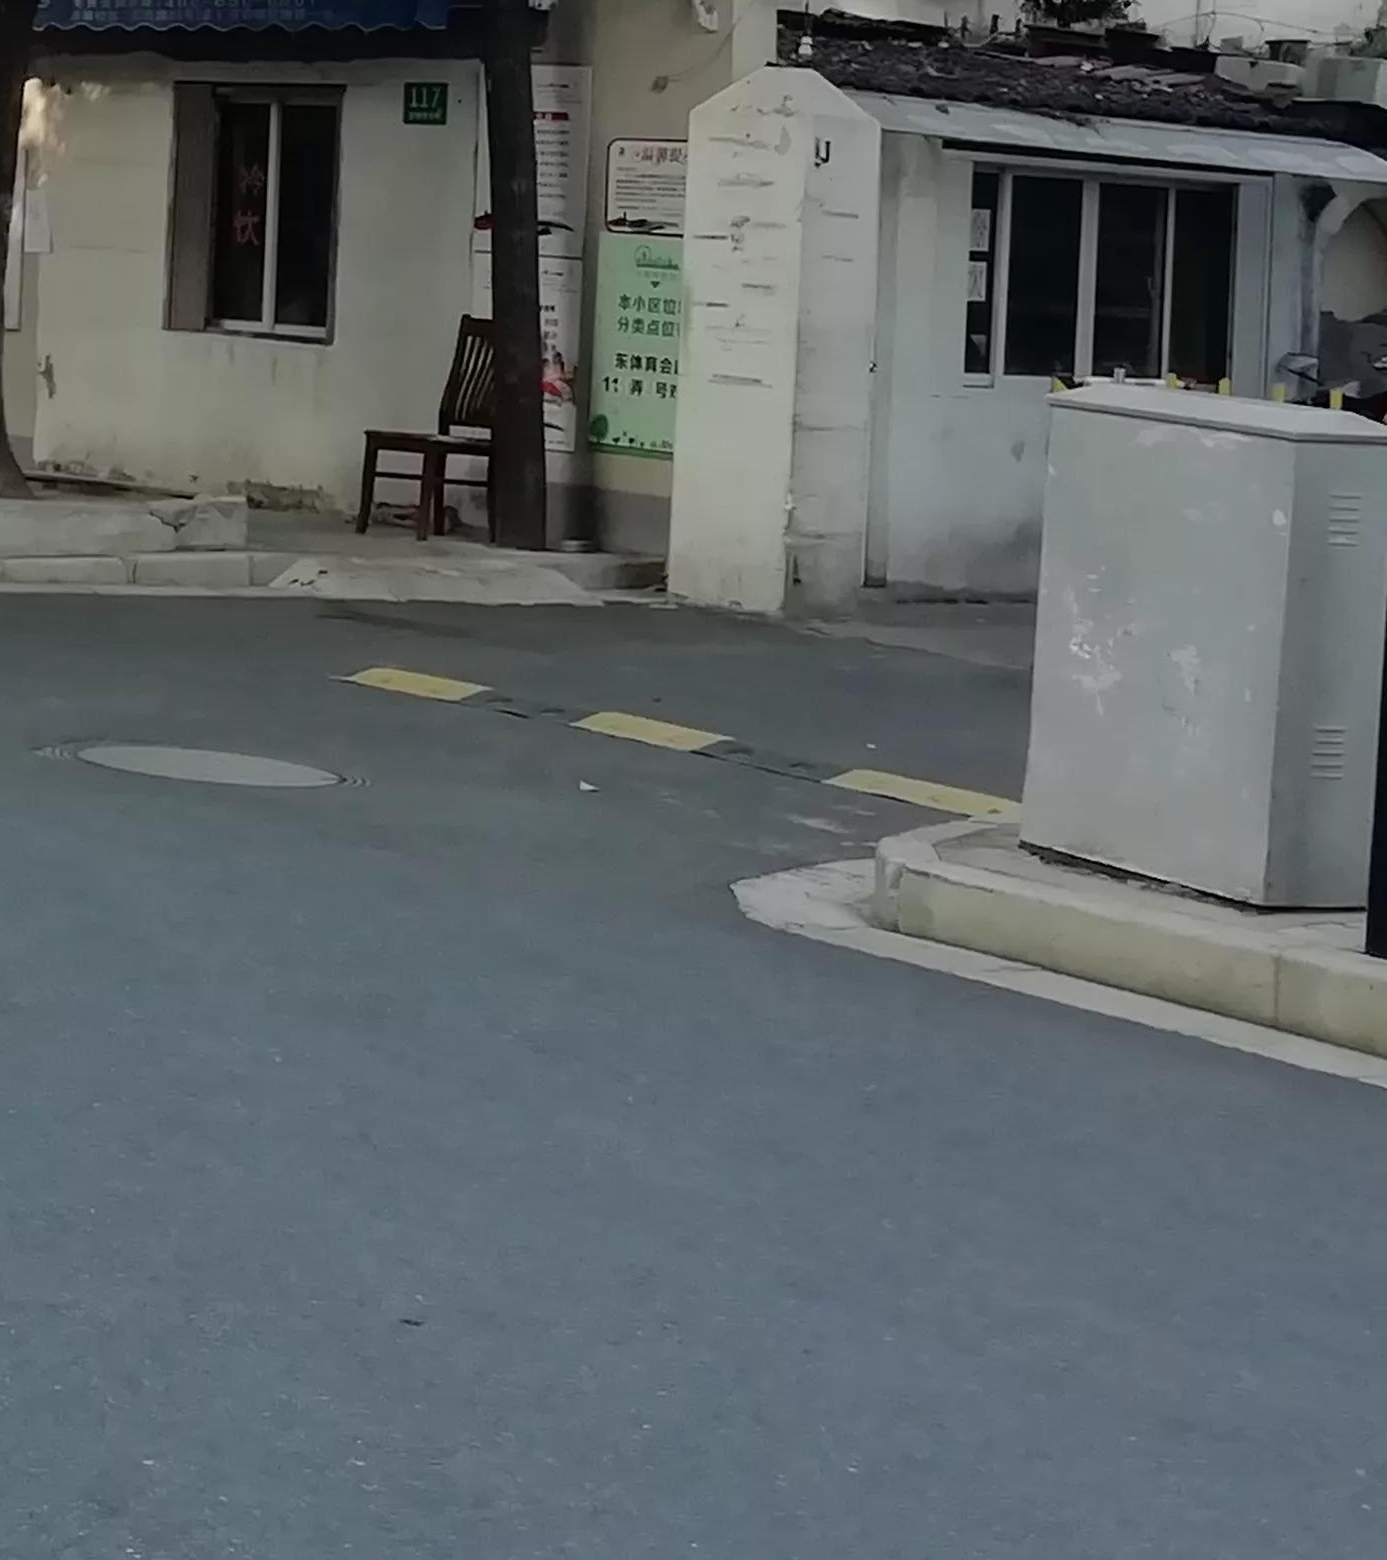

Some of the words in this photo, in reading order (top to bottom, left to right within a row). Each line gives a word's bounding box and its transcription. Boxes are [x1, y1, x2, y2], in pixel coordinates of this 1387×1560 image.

[410, 87, 441, 108] 117
[617, 293, 681, 316] 本小区垃
[616, 316, 681, 338] 分类点位
[614, 352, 679, 376] 东体育会
